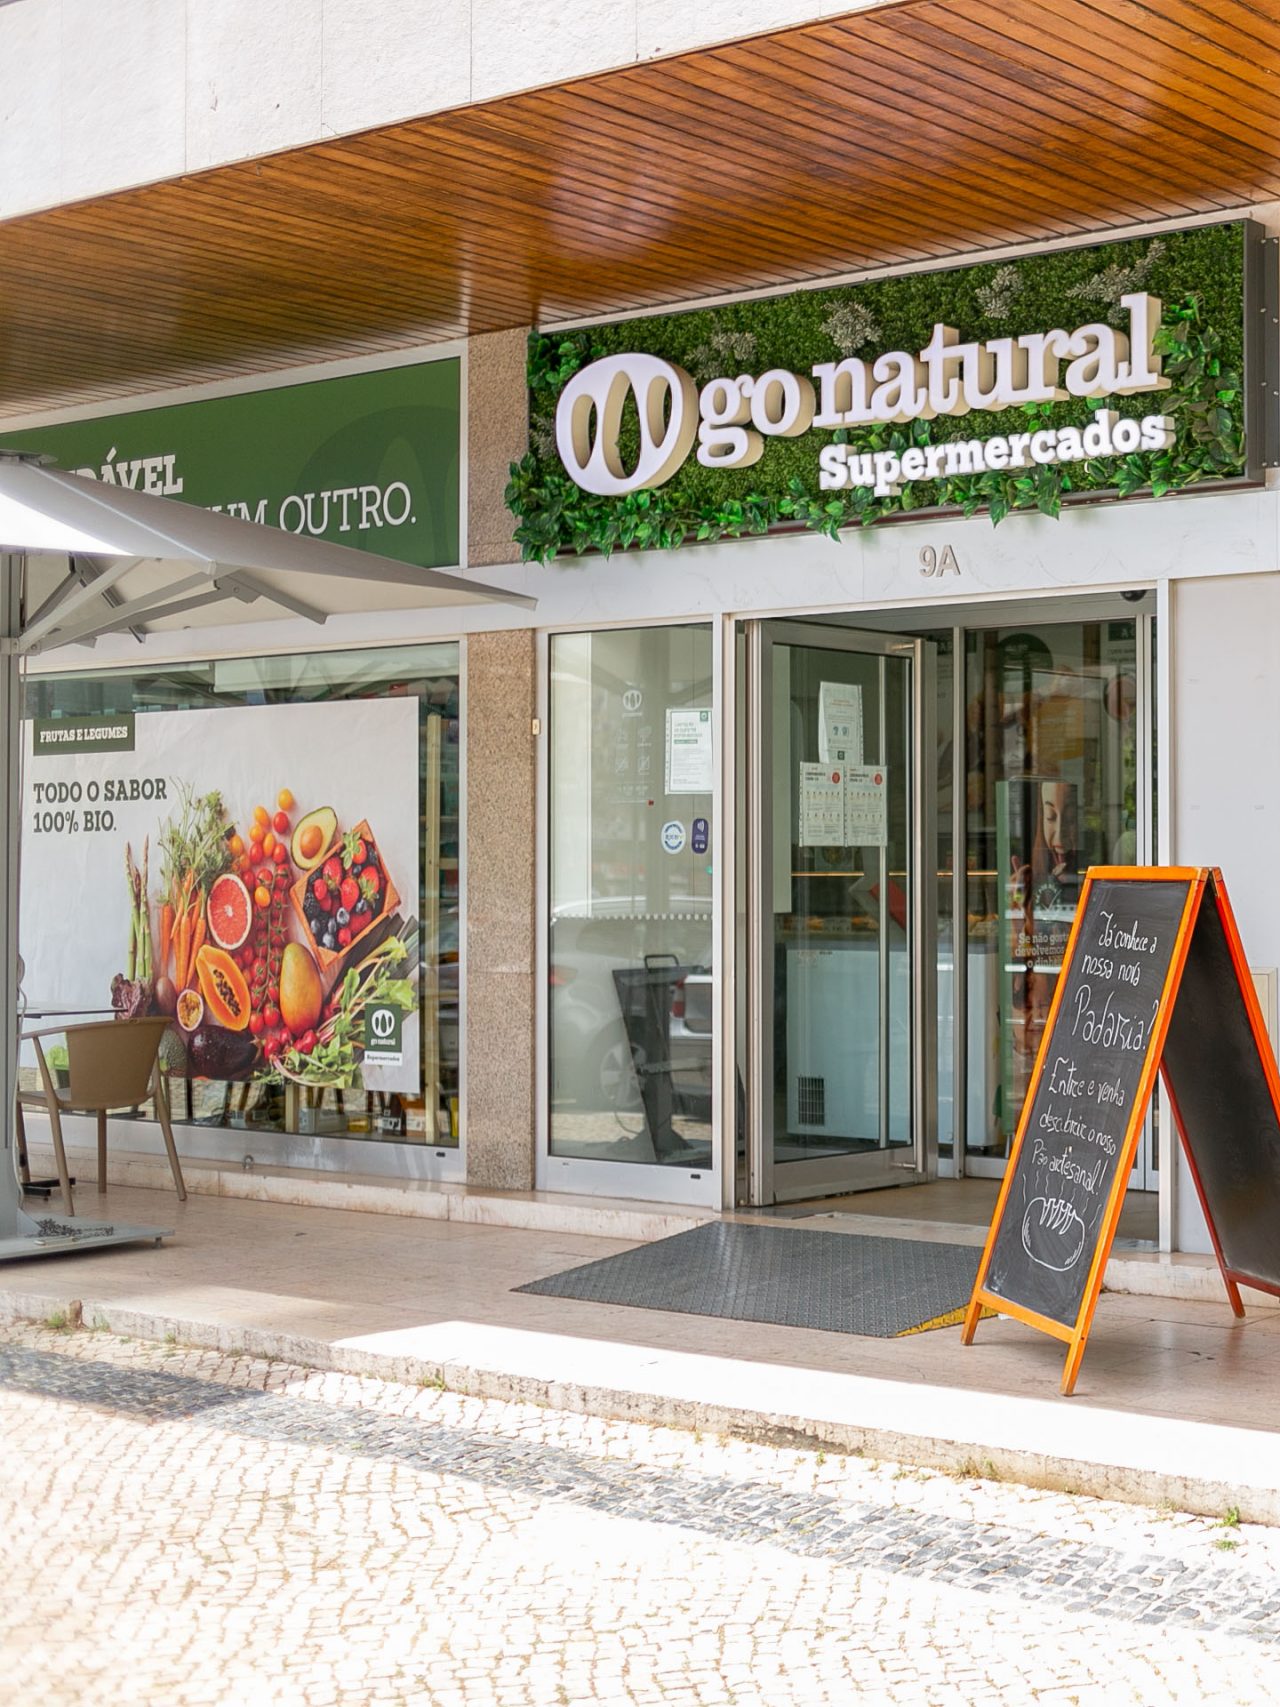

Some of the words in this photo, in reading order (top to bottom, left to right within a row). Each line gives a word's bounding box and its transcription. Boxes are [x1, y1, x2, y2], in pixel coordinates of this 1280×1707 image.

[697, 368, 808, 469] go
[812, 291, 1165, 430] natural
[818, 408, 1173, 497] Supermercados
[66, 446, 183, 496] ÁVEL
[279, 481, 417, 535] OUTRO.
[920, 544, 961, 577] 9A
[40, 730, 75, 743] FRUTAS
[76, 728, 83, 741] E
[84, 726, 128, 740] LEGUMES
[33, 781, 82, 804] TODO
[87, 781, 100, 802] O
[104, 778, 167, 801] SABOR
[33, 810, 79, 834] 100%
[83, 810, 117, 832] BIO.
[1018, 933, 1031, 944] Se
[1032, 932, 1048, 943] não
[1114, 920, 1149, 951] conhece
[1082, 954, 1114, 979] nossa
[1118, 961, 1141, 986] nova
[1072, 984, 1159, 1050] Padaria?
[1049, 1057, 1086, 1097] Entre
[1087, 1080, 1095, 1096] e
[1097, 1078, 1125, 1106] venha
[1088, 1128, 1096, 1142] o
[1096, 1132, 1116, 1155] nosso
